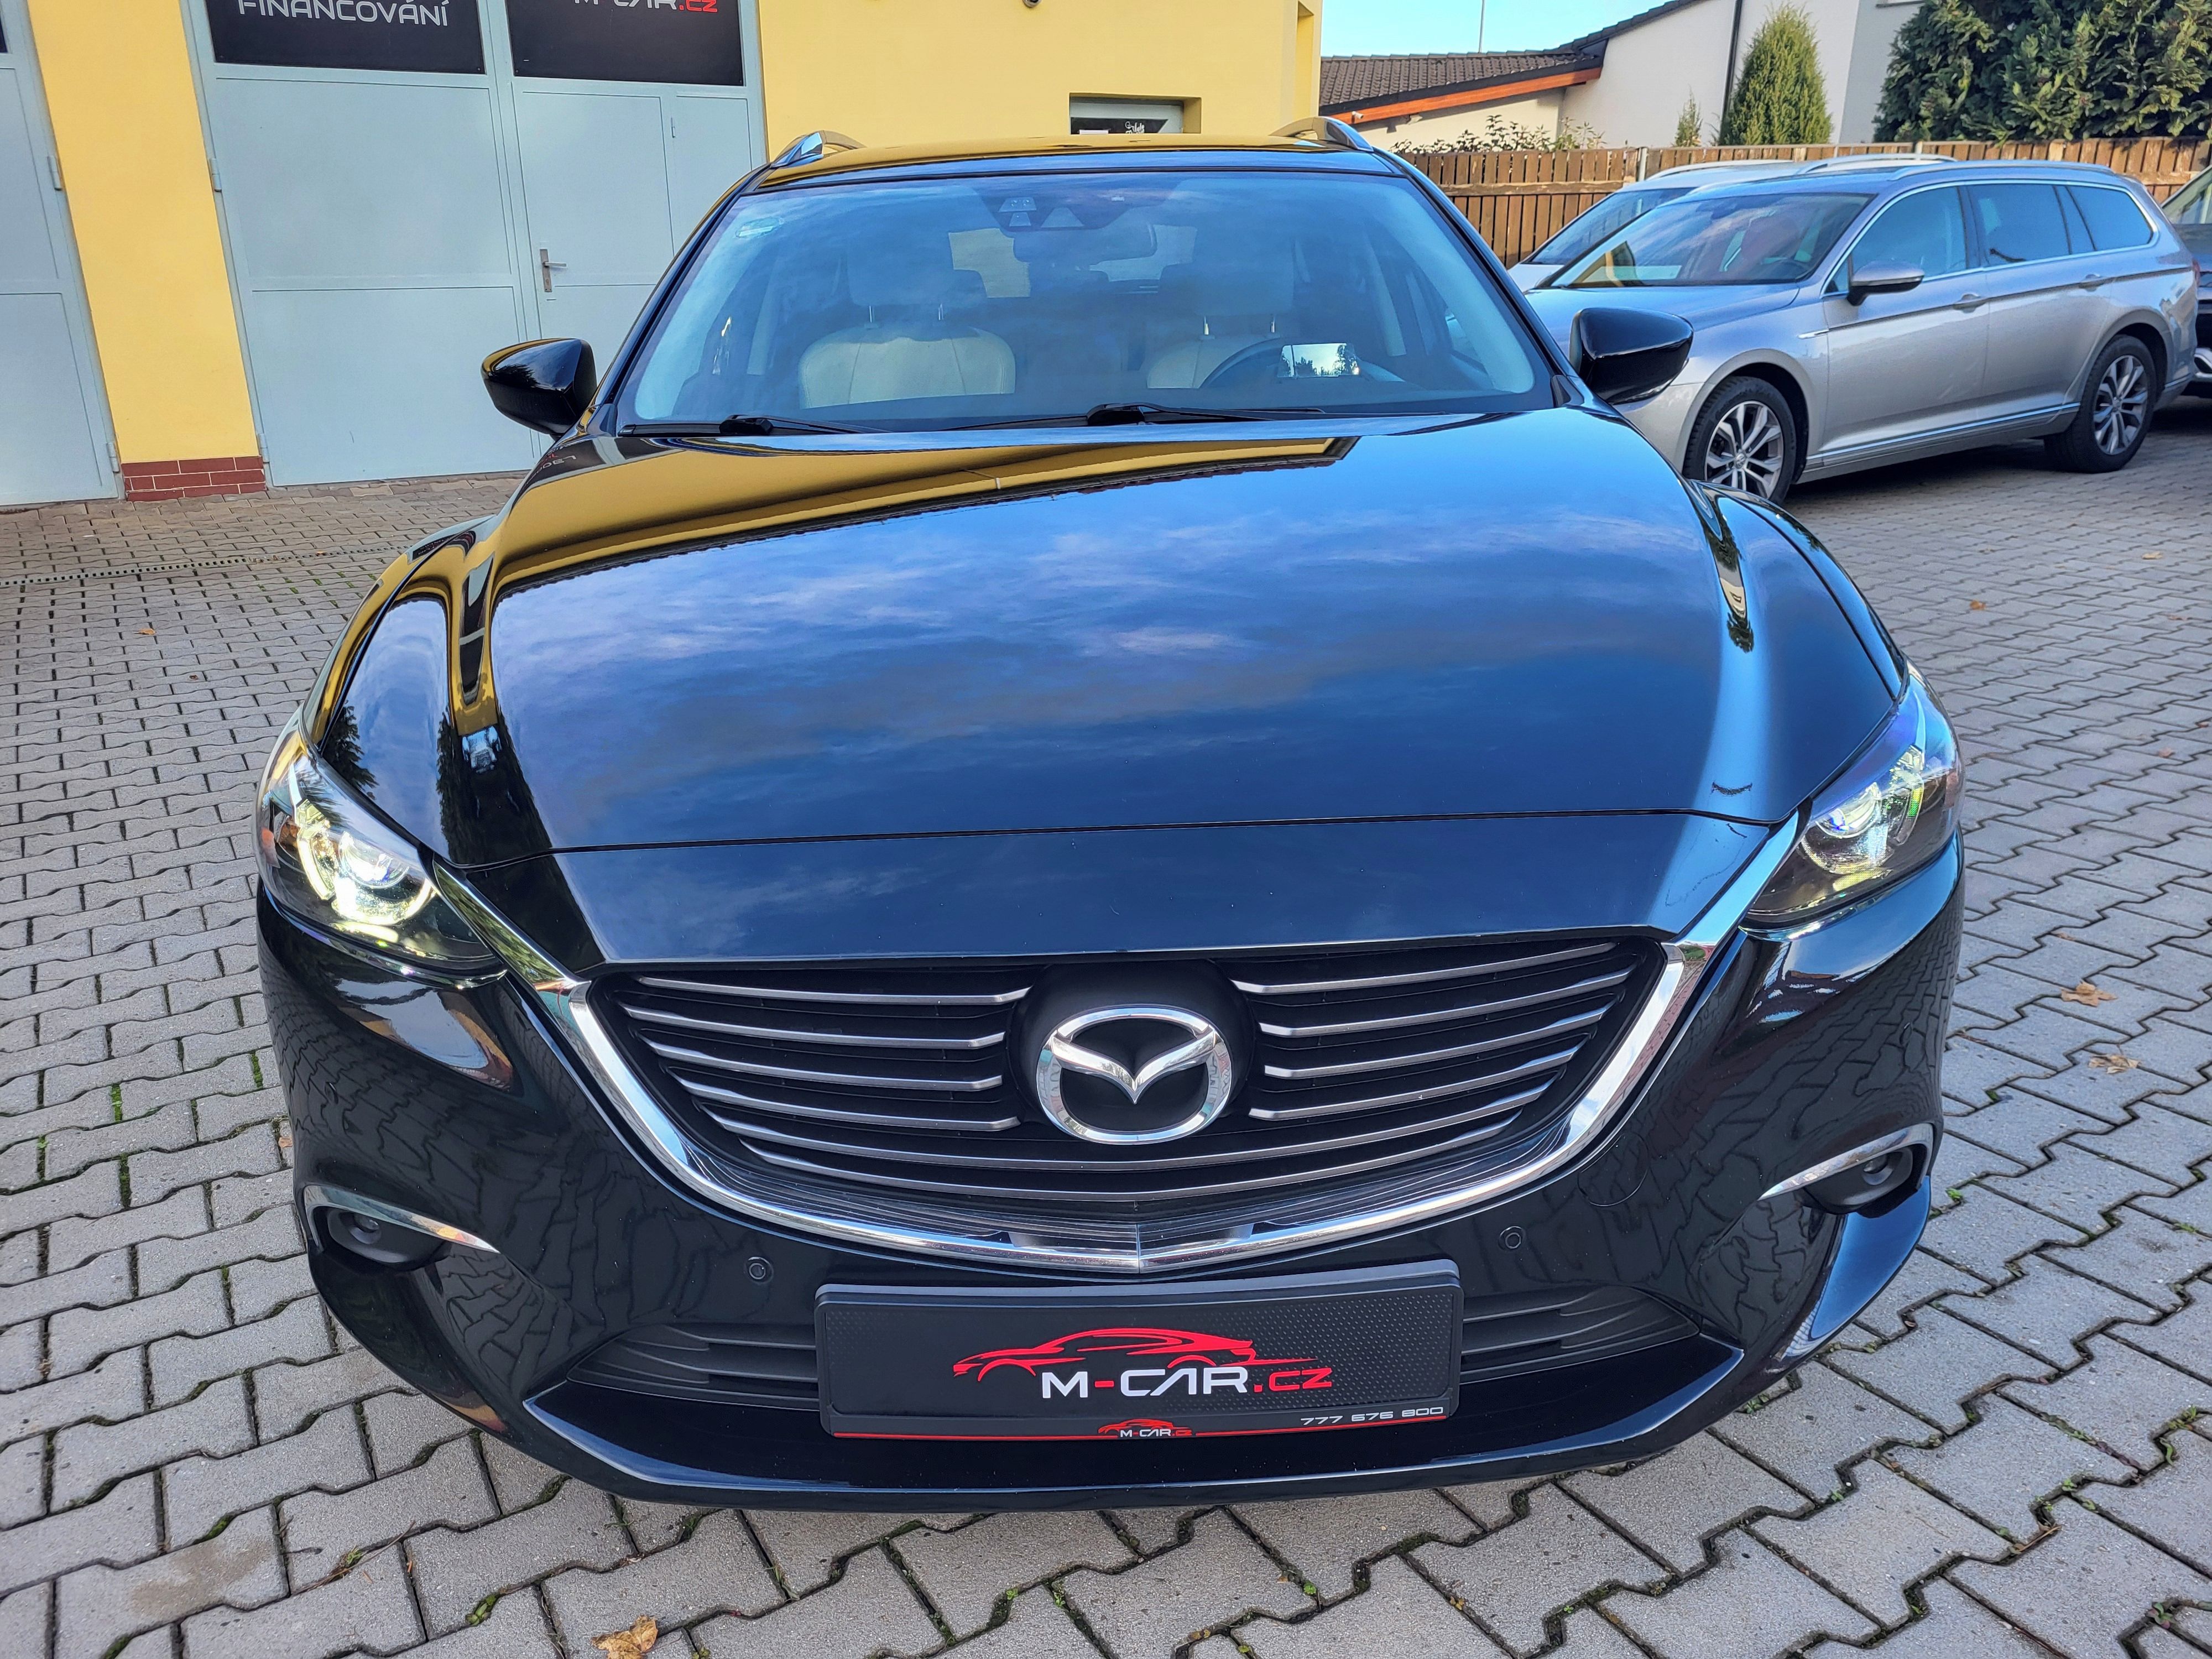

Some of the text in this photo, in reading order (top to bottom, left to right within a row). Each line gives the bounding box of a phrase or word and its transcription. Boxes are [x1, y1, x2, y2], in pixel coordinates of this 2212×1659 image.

[238, 0, 450, 26] FINANCOVÁNÍ
[1301, 1406, 1444, 1425] 777 676 800
